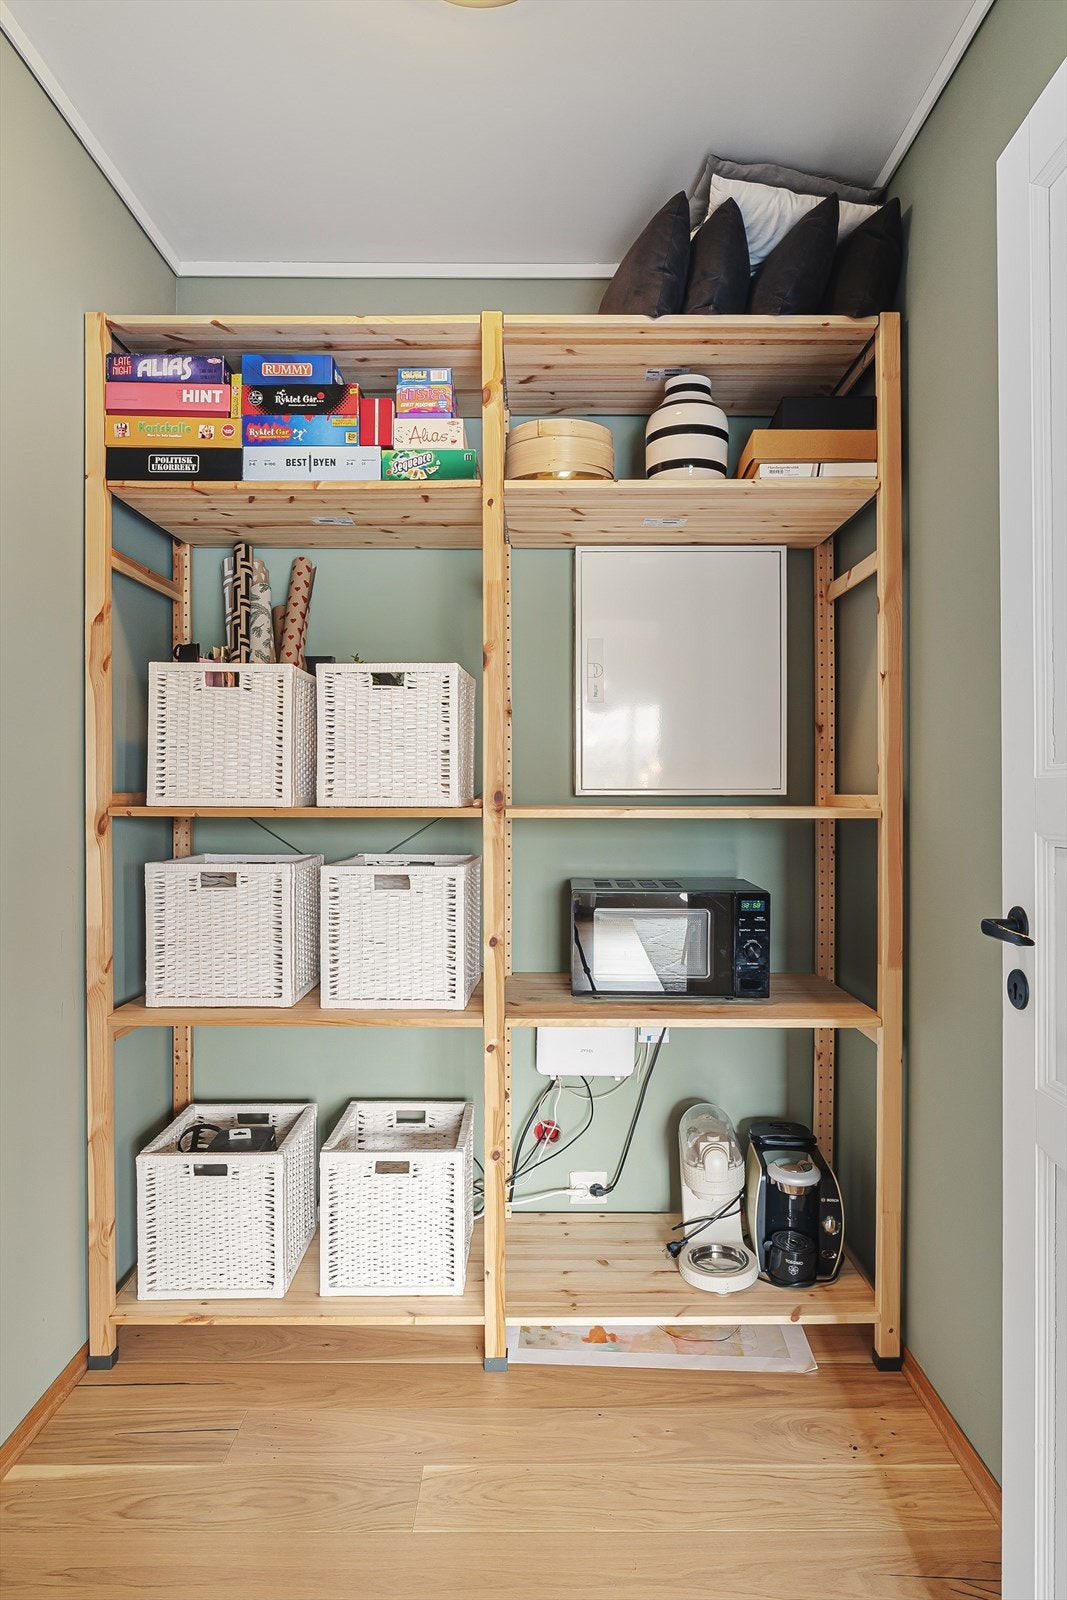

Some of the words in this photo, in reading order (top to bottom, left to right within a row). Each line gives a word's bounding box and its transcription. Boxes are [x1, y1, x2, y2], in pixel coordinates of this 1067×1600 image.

[113, 356, 131, 366] LATE
[112, 365, 132, 375] NIGHT
[137, 356, 192, 380] ALIAS
[265, 364, 310, 375] RUMMY
[182, 389, 223, 403] HINT
[400, 387, 446, 400] HITSTER
[274, 395, 301, 405] Ryktet
[138, 421, 192, 433] Kortskalle
[249, 428, 274, 438] Ryktet
[408, 425, 448, 444] Alias
[151, 463, 196, 471] UKORREKT
[285, 458, 307, 467] BEST
[313, 458, 336, 467] BYEN
[393, 453, 433, 474] Sequence
